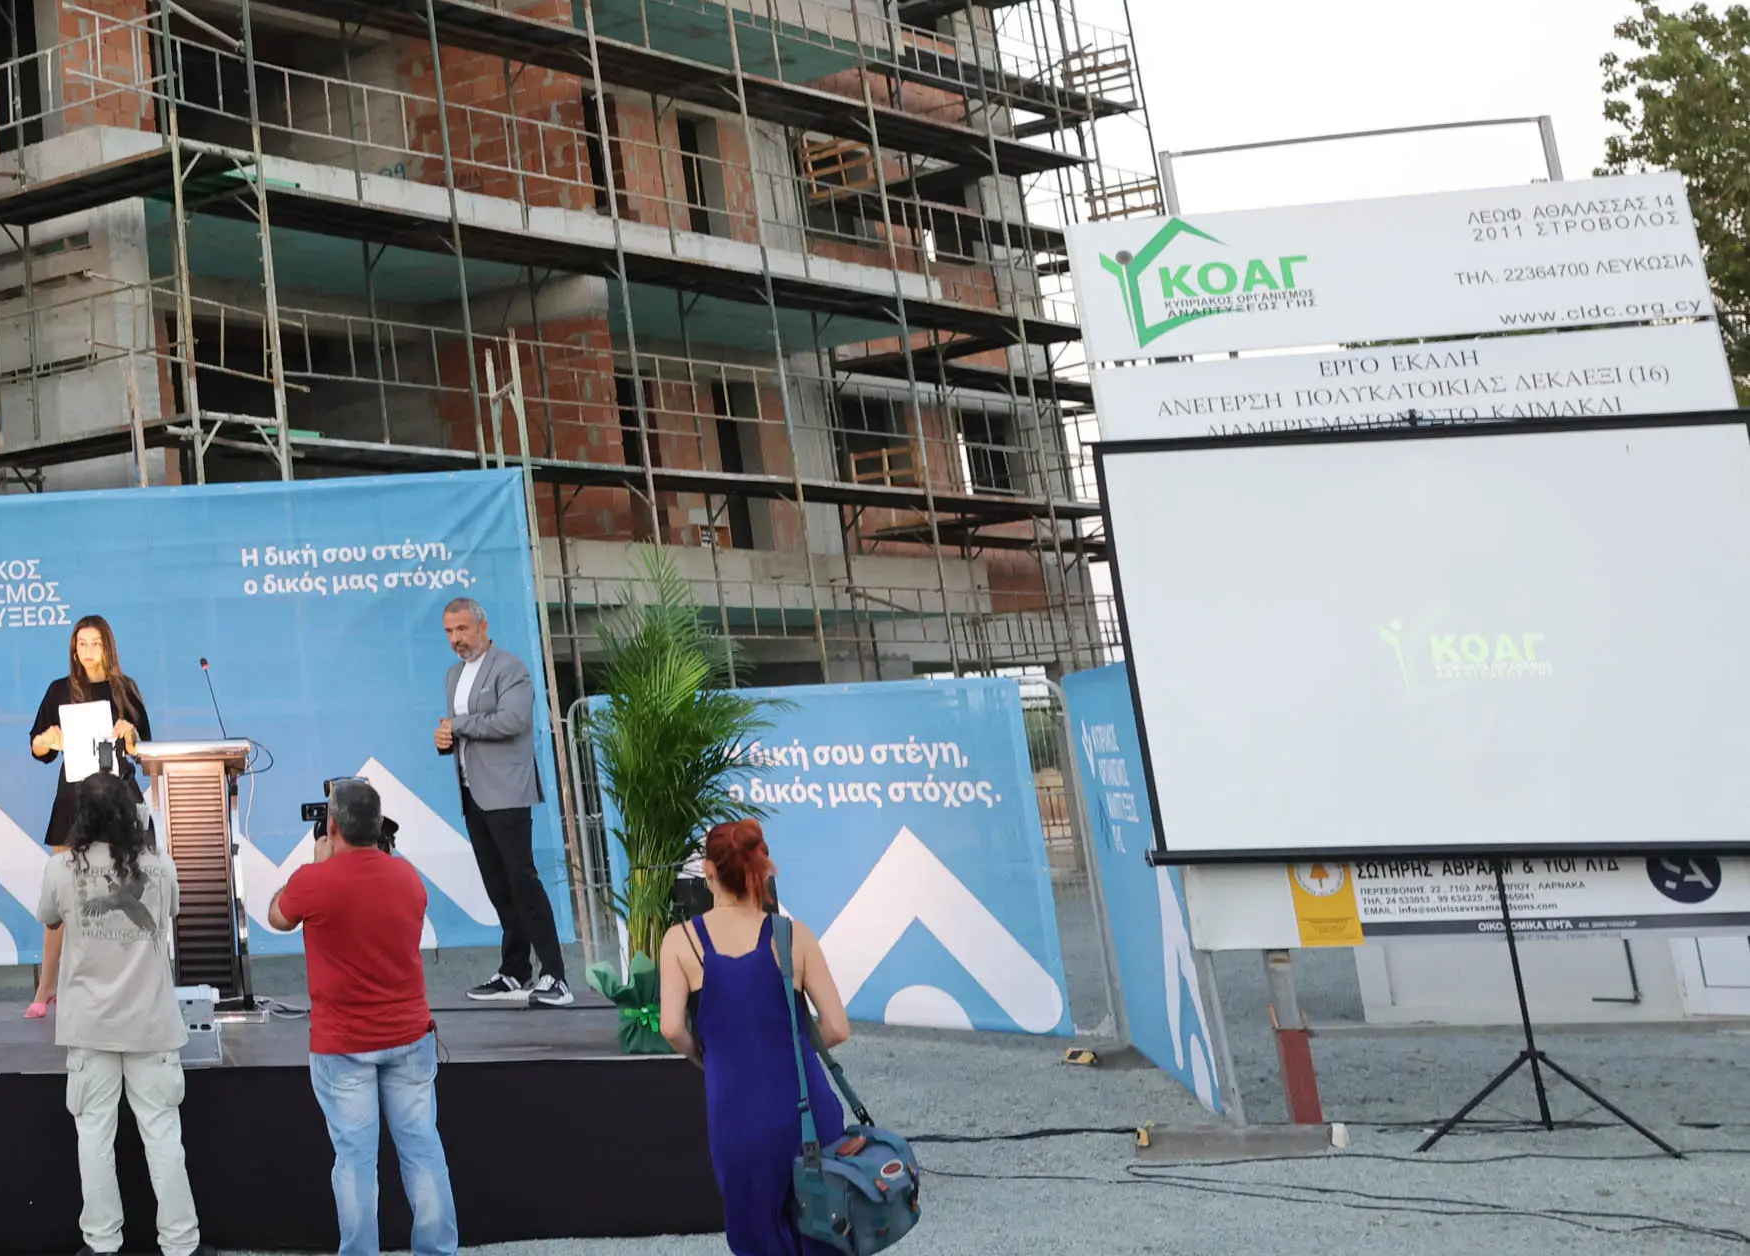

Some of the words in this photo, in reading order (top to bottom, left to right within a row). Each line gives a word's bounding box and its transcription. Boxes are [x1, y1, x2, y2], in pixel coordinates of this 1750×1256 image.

[1533, 195, 1649, 220] ΑΘΑΛΑΣΣΑΣ
[1654, 194, 1675, 209] 14
[1473, 224, 1523, 242] 2011
[1536, 210, 1680, 237] ΣΤΡΟΒΟΛΟΣ
[1158, 255, 1308, 299] ΚΟΑΓ
[1504, 261, 1590, 283] 22364700
[1595, 253, 1694, 274] ΛΕΥΚΩΣΙΑ
[1164, 296, 1232, 309] ΚΥΠΡΙΑΚΟΣ
[1237, 289, 1315, 303] ΟΡΓΑΝΙΣΜΟΣ
[1167, 303, 1279, 319] ΑΝΑΠΤΥΞΕΩΣ
[1285, 298, 1317, 309] ΓΗΣ
[1499, 298, 1702, 325] www.cldc.org.cy
[1319, 357, 1380, 378] ΕΡΓΟ
[1392, 349, 1480, 373] ΕΚΑΛΗ
[1157, 391, 1282, 417] ΑΝΕΓΕΡΣΗ
[1295, 375, 1507, 408] ΠΟΛΥΚΑΤΟΙΚΙΑΣ
[1515, 367, 1622, 391] ΔΕΚΑΕΞΙ
[1628, 365, 1670, 385] (16)
[1491, 396, 1623, 418] ΚΑΙΜΑΚΛΙ
[241, 548, 258, 567] Η
[264, 543, 318, 568] δική
[322, 545, 366, 563] σου
[372, 538, 452, 562] στέγη,
[243, 579, 258, 595] ο
[263, 571, 327, 596] δικός
[333, 572, 378, 594] μας
[383, 566, 477, 590] στόχος.
[1430, 632, 1545, 662] ΚΟΑΓ
[749, 739, 809, 771] δική
[813, 743, 865, 766] σου
[870, 735, 969, 769] στέγη,
[750, 776, 823, 809] δικός
[829, 781, 882, 809] μας
[888, 774, 1002, 809] στόχος.
[1356, 861, 1434, 879] ΣΩΤΗΡΗΣ
[1522, 859, 1534, 874] &
[1538, 881, 1586, 890] ΛΑΡΝΑΚΑ
[1478, 921, 1546, 932] ΟΙΚΟΟΜΙΚΑ
[1546, 920, 1573, 930] ΕΡΓΑ
